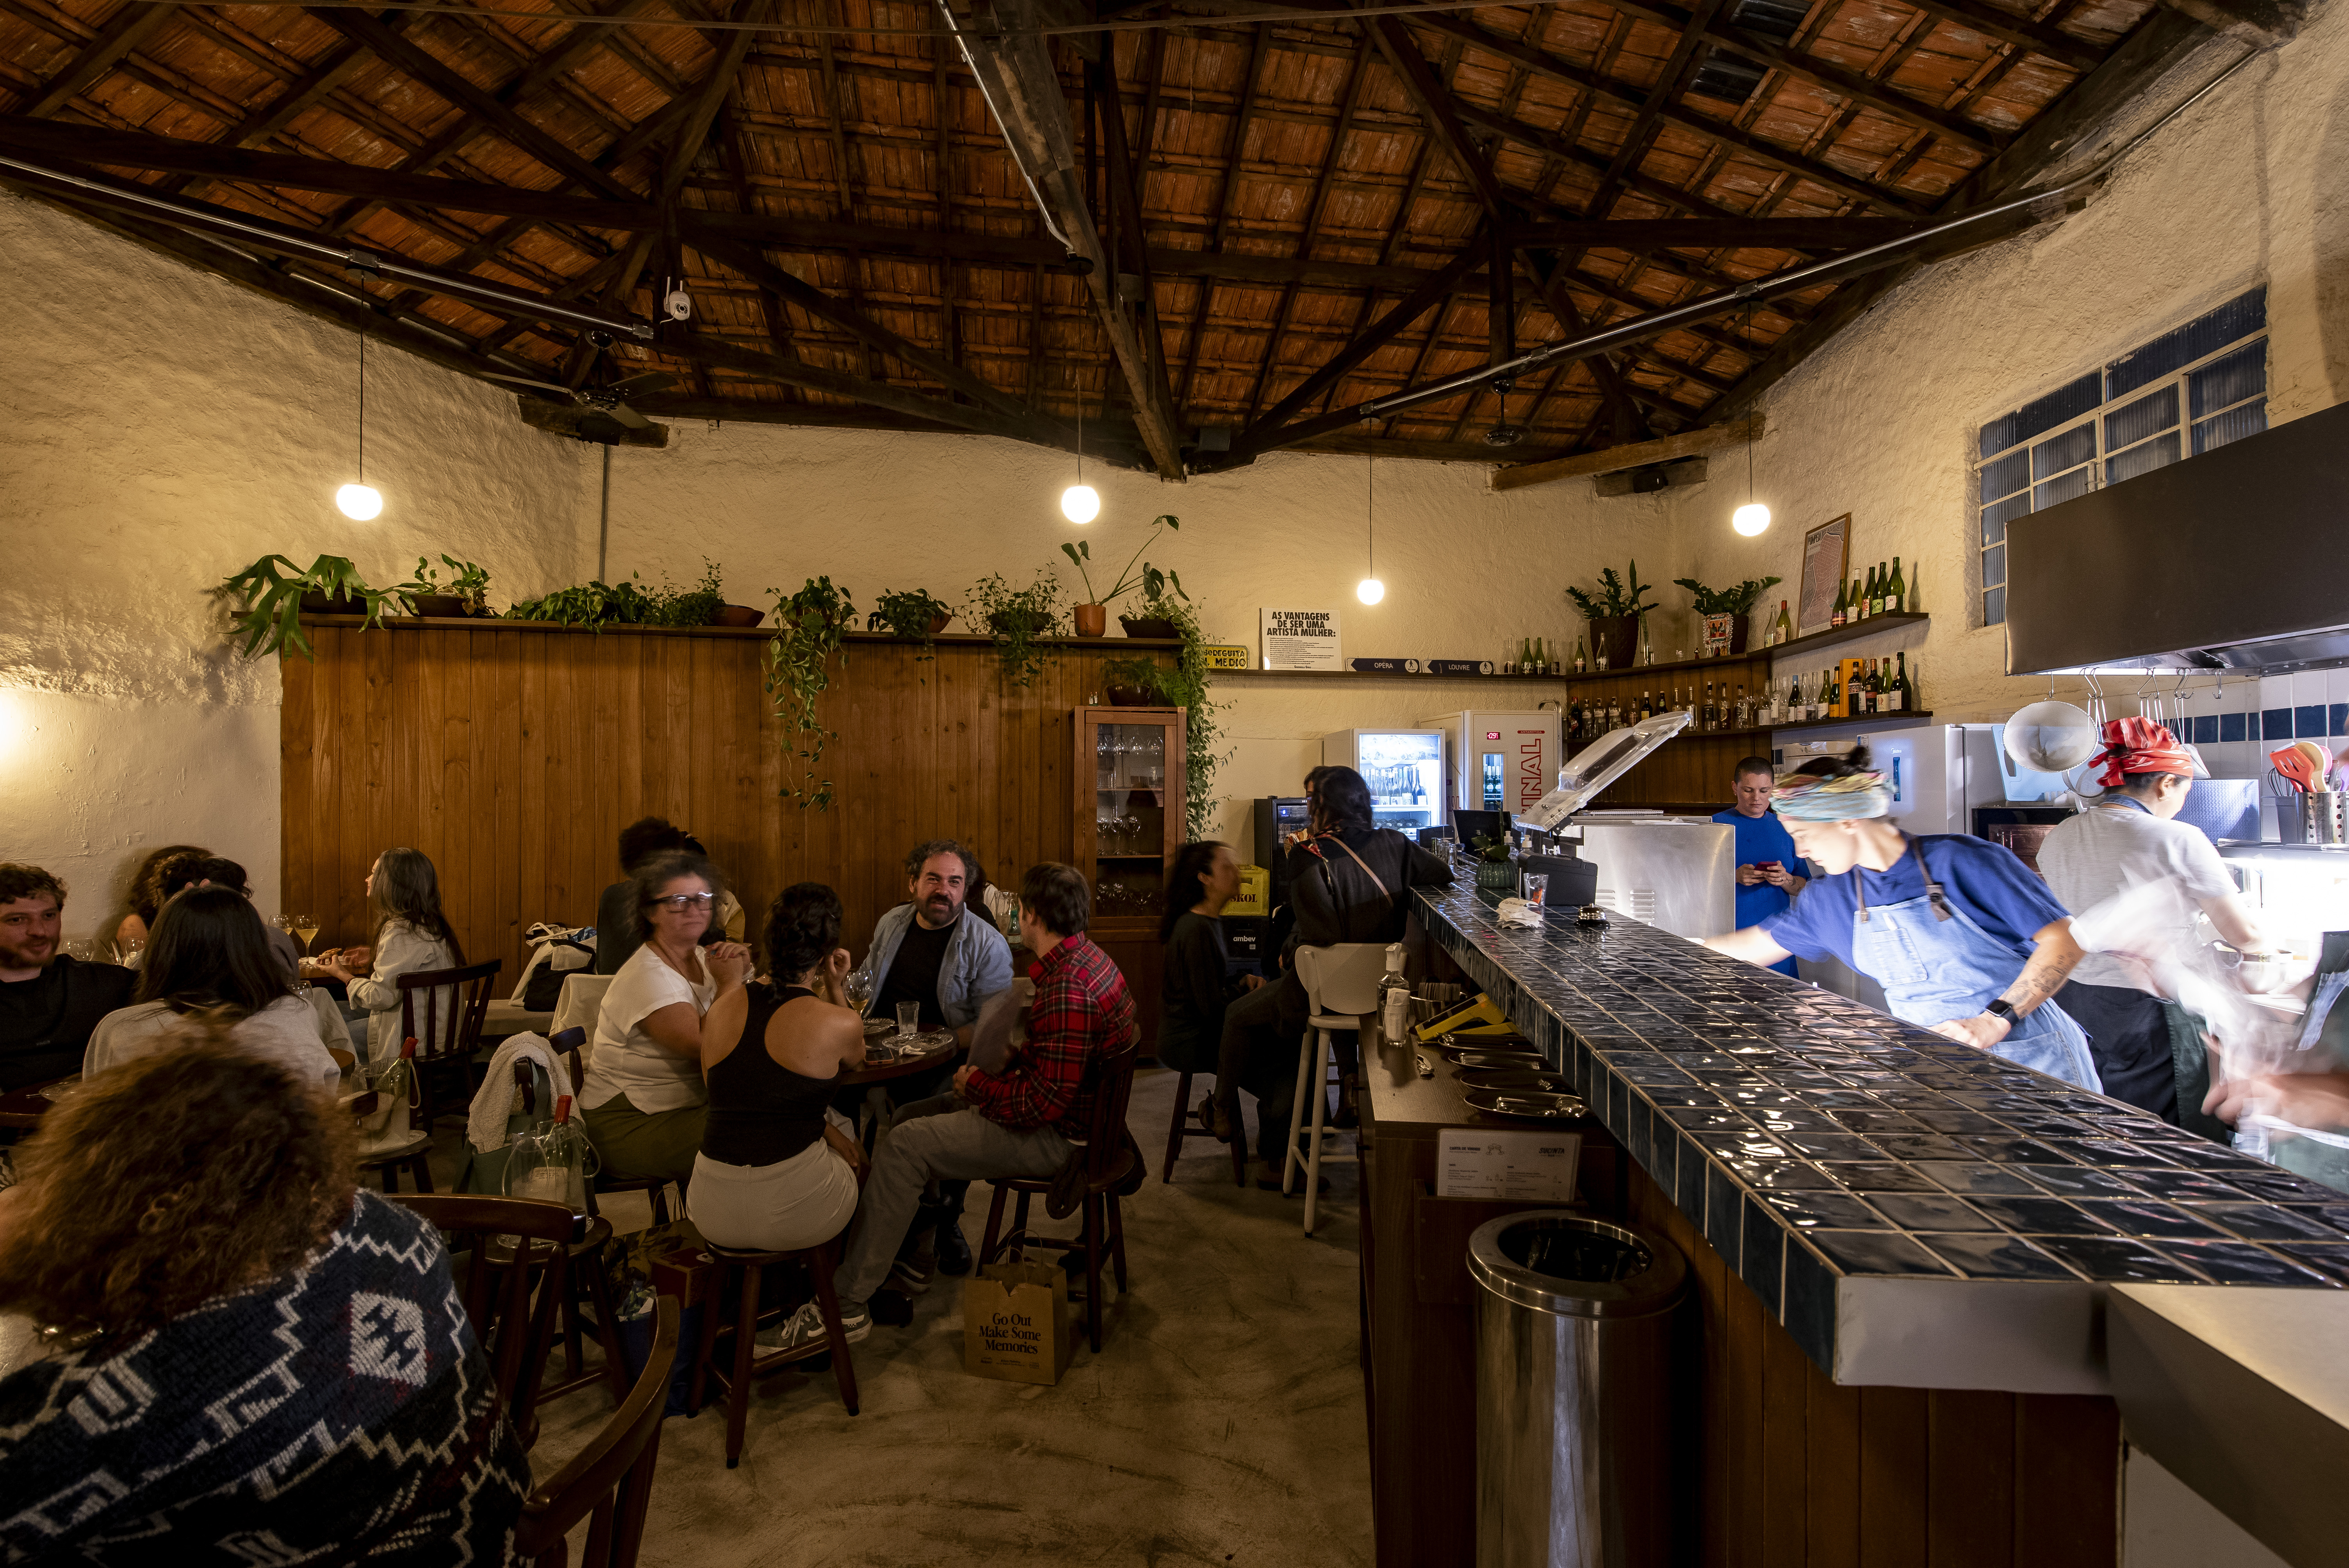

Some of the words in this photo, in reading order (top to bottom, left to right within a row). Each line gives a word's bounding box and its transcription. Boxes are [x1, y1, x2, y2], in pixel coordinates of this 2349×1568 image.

[1272, 611, 1282, 620] AS
[1283, 611, 1330, 621] VANTAGENS
[1277, 620, 1287, 628] DE
[1290, 620, 1304, 628] SER
[1306, 620, 1325, 629] UMA
[1267, 627, 1299, 636] ARTISTA
[1300, 628, 1336, 637] MULHER:
[1215, 658, 1246, 667] MEDIO
[1520, 738, 1542, 814] INAL
[1230, 894, 1258, 903] SKOL
[993, 1313, 1008, 1325] Go
[1011, 1314, 1031, 1326] Out
[979, 1326, 1009, 1338] Make
[1012, 1327, 1041, 1341] Some
[985, 1340, 1038, 1354] Memories
